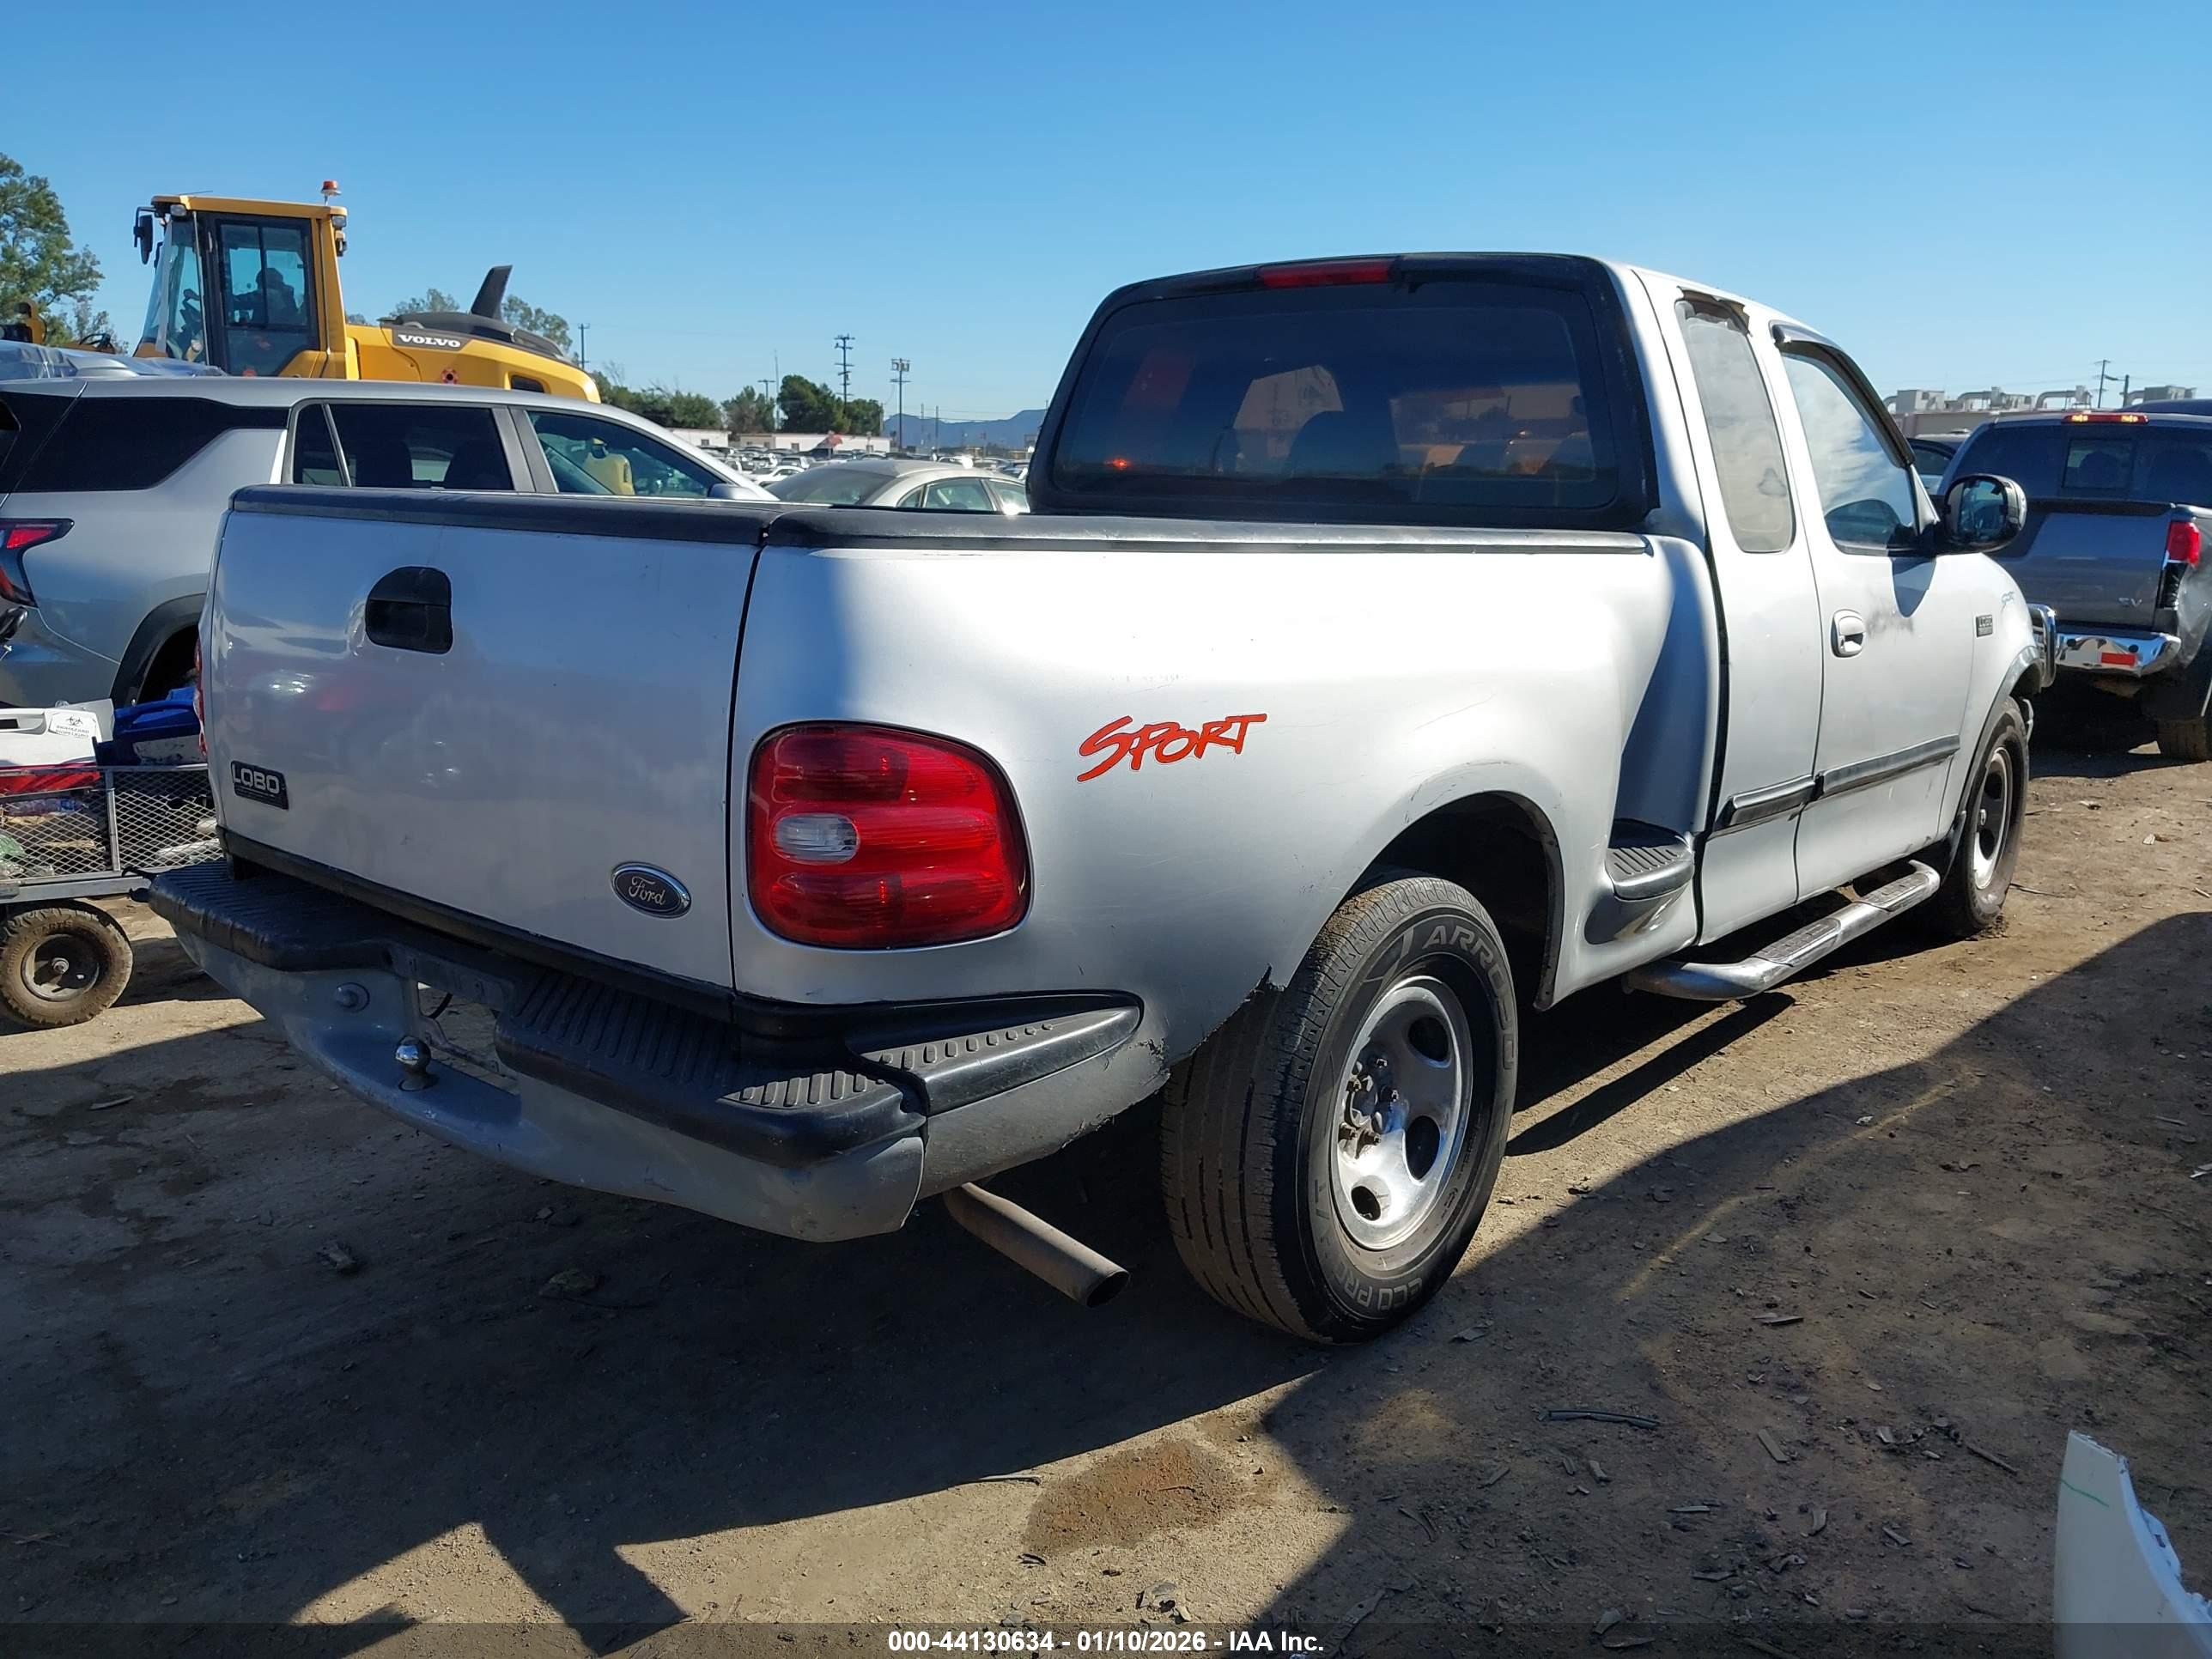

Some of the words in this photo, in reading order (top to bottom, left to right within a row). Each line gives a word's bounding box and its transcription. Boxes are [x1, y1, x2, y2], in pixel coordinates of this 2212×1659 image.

[398, 334, 461, 348] VOLVO
[1077, 715, 1267, 782] SPORT
[231, 763, 280, 794] LOBO
[628, 876, 666, 906] Ford
